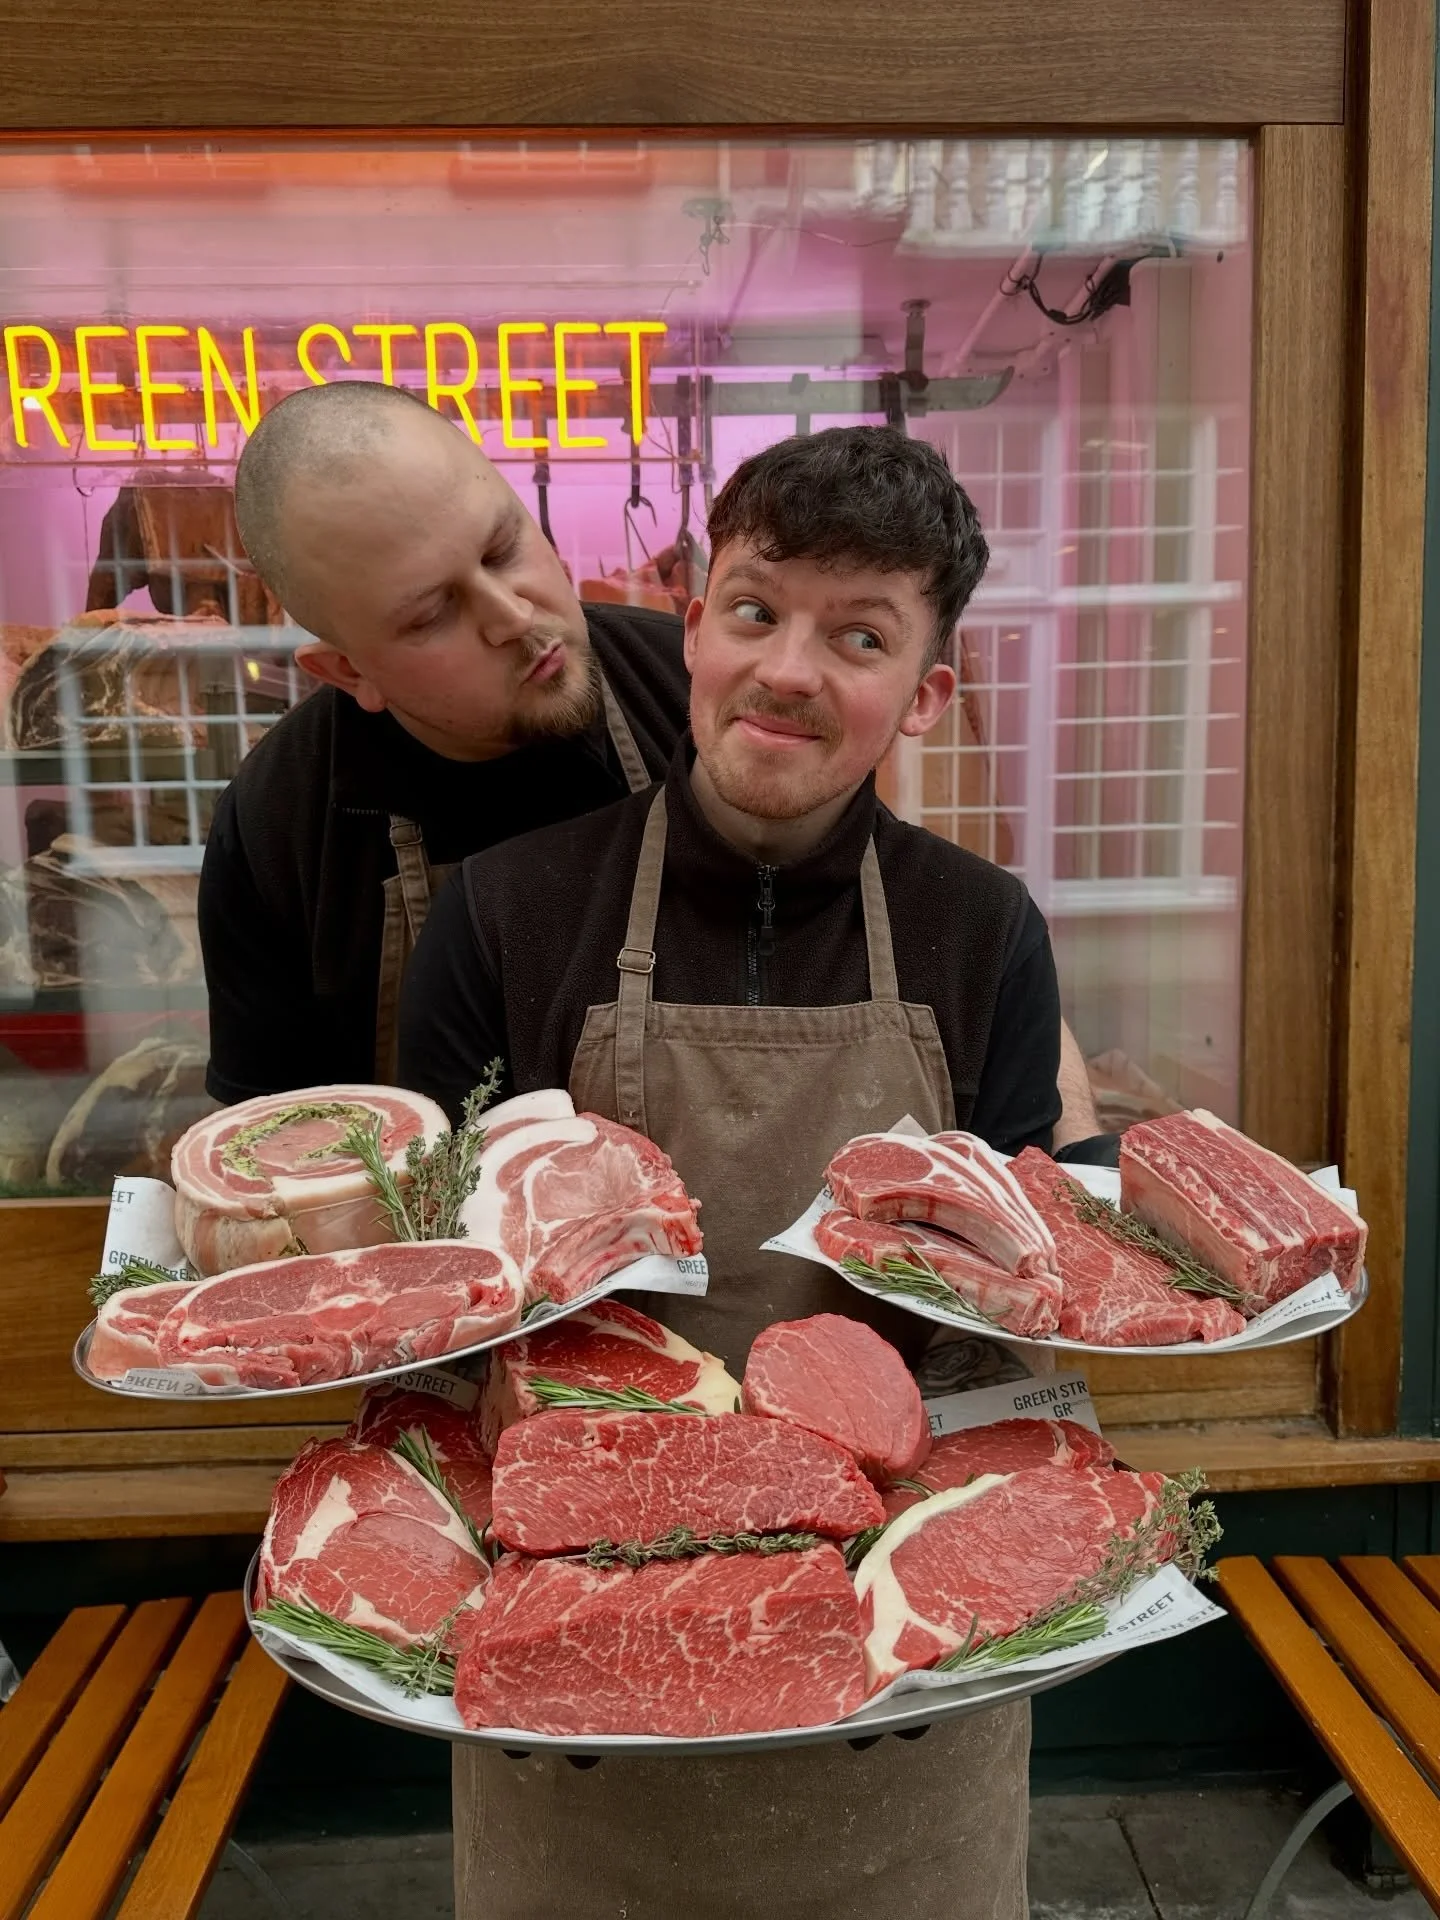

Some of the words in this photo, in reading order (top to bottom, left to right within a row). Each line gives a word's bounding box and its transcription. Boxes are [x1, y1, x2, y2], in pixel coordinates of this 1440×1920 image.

[676, 1259, 707, 1275] GREE
[404, 1371, 457, 1396] STREET
[1013, 1387, 1058, 1411] GREEN
[1059, 1380, 1088, 1398] STR
[1116, 1591, 1175, 1632] STREET
